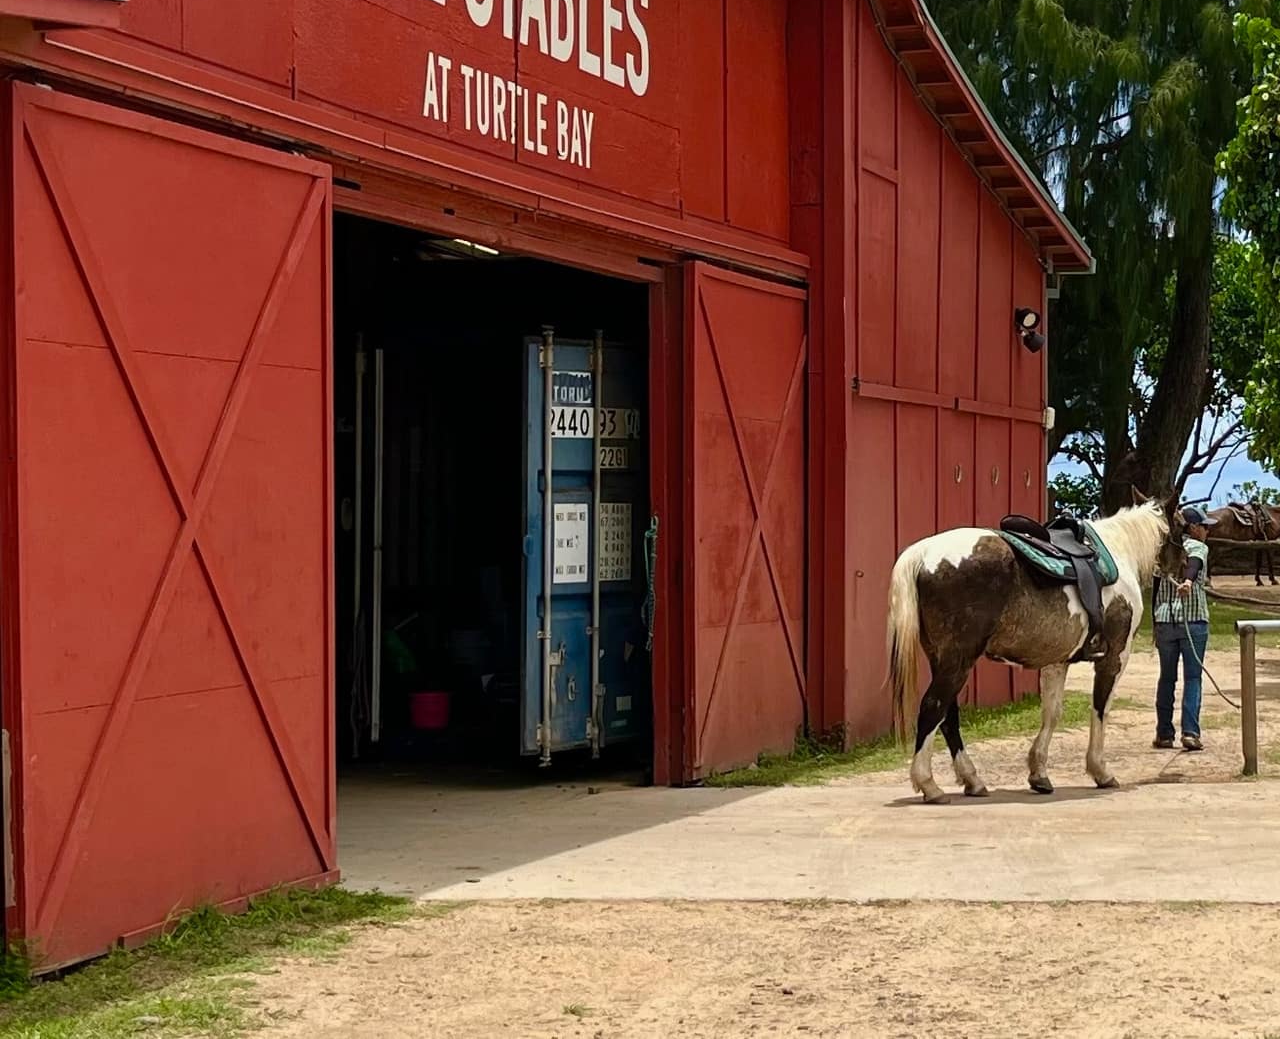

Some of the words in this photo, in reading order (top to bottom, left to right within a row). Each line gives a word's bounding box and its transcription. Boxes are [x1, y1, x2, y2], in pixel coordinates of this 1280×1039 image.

[423, 51, 452, 123] AT
[460, 64, 548, 155] TURTLE
[556, 99, 595, 169] BAY
